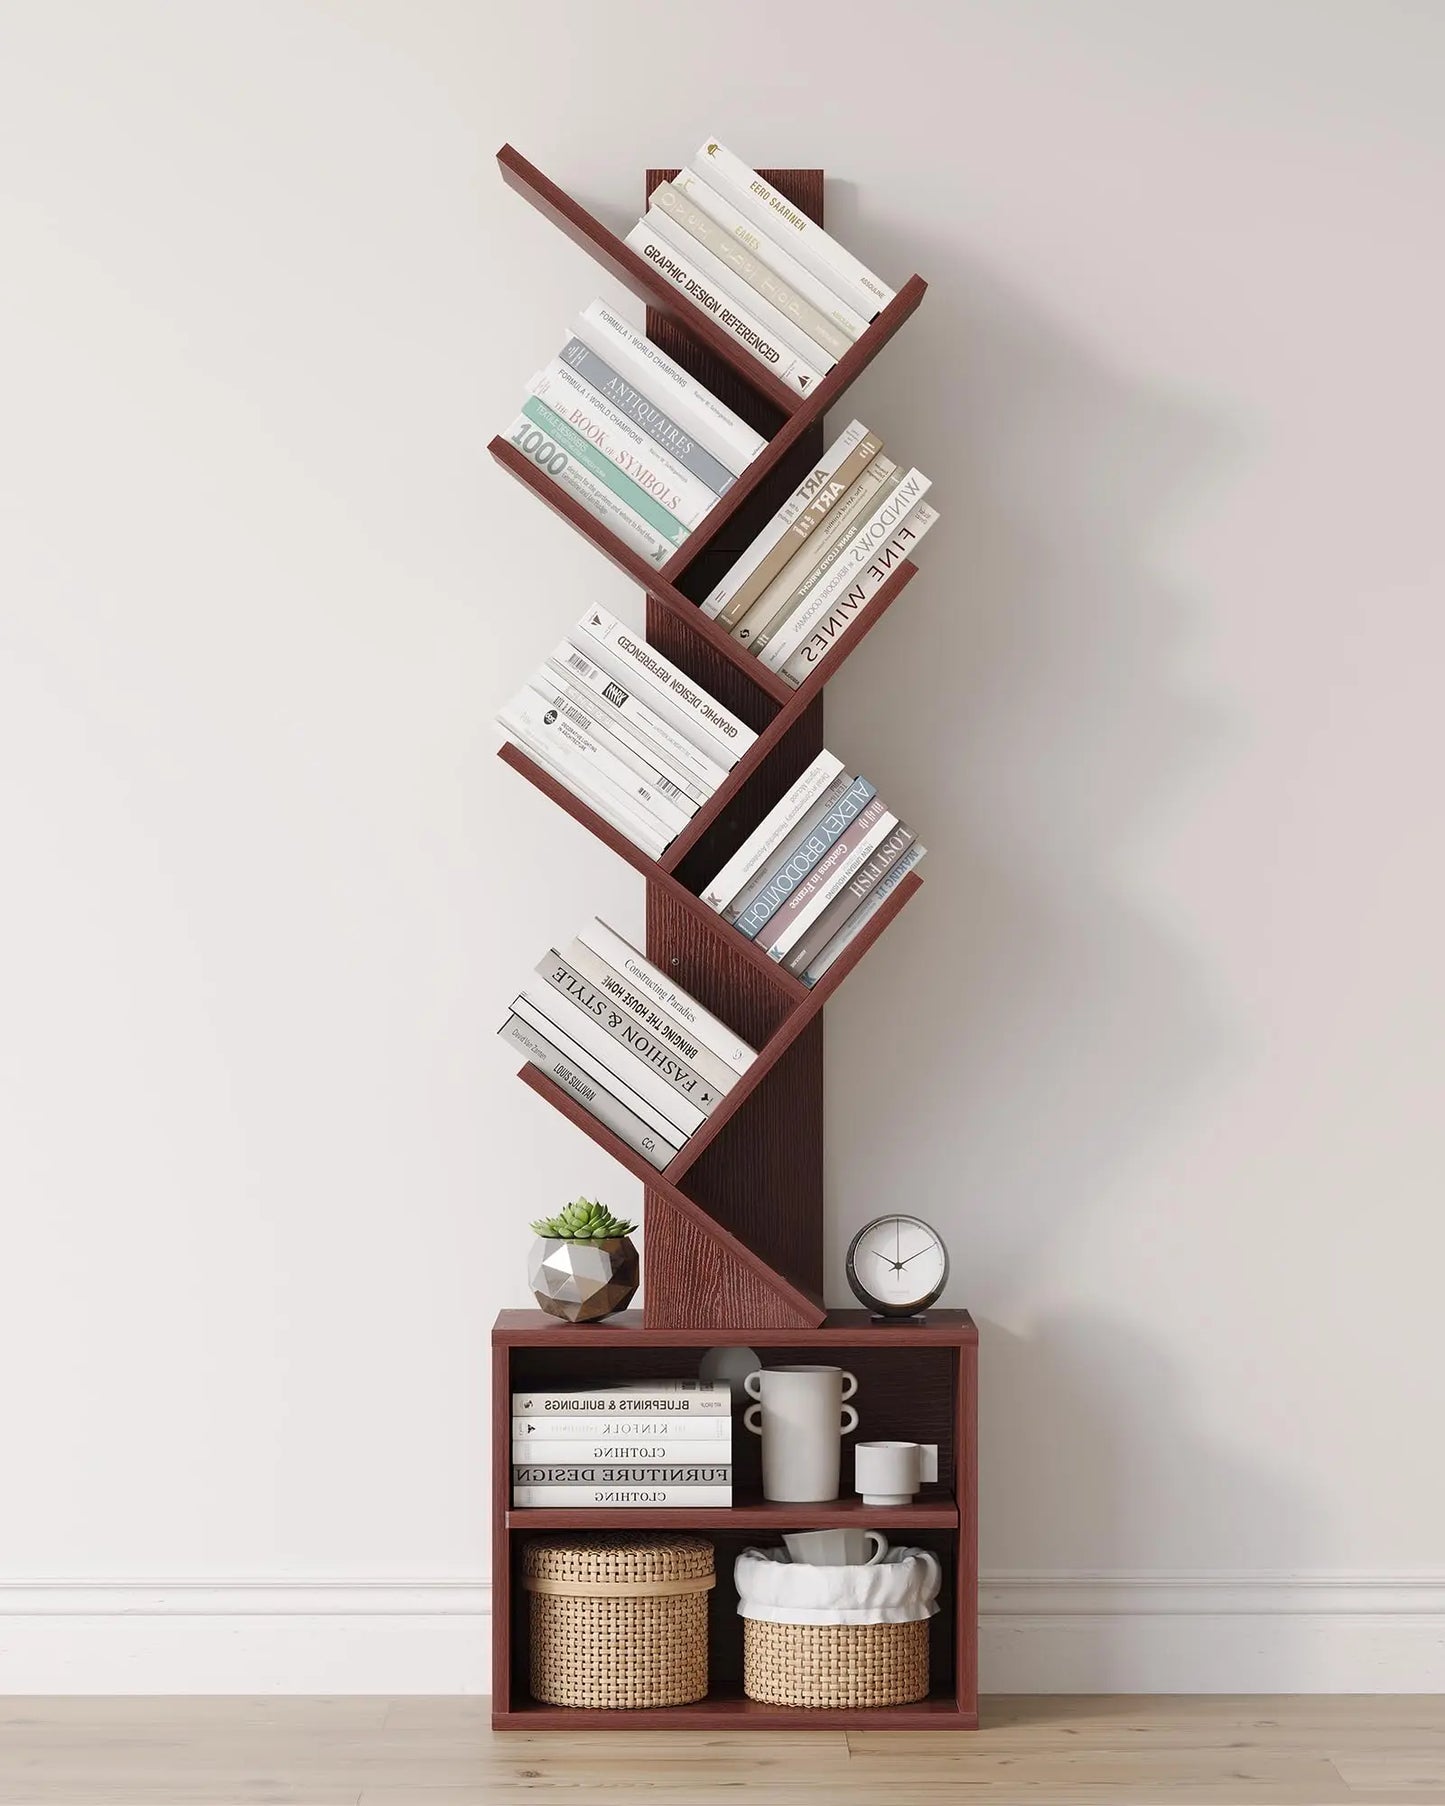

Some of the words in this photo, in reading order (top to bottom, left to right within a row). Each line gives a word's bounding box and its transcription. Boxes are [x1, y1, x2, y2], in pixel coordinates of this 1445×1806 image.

[749, 180, 772, 202] EERO
[767, 196, 808, 233] SAARINEN
[733, 225, 763, 252] EAMES
[642, 243, 689, 285] GRAPHIC
[683, 278, 723, 314] DESIGN
[717, 308, 782, 365] REFERENCED
[598, 309, 630, 338] FORMULA
[630, 337, 655, 360] WORLD
[651, 355, 689, 389] CHAMPIONS
[557, 368, 587, 396] FORMULA
[588, 395, 612, 417] WORLD
[608, 413, 645, 446] CHAMPIONS
[604, 375, 696, 457] ANTIQUAIRES
[510, 419, 572, 479] 1000
[567, 408, 611, 448] BOOK
[614, 448, 683, 512] SYMBOLS
[615, 634, 673, 685] REFERENCED
[668, 678, 703, 710] DESIGN
[698, 703, 740, 740] GRAPHIC
[817, 780, 873, 843] ALEXEY
[817, 842, 849, 878] Gardens
[844, 855, 864, 877] URBAN
[860, 843, 874, 859] NEW
[873, 825, 913, 869] LOST
[743, 835, 827, 930] BRODOVITCH
[810, 872, 823, 885] in
[824, 874, 848, 901] HOUSING
[847, 861, 883, 900] FISH
[883, 848, 920, 890] MAKING
[788, 881, 816, 911] France
[873, 886, 889, 901] IT
[550, 965, 609, 1018] STYLE
[599, 973, 627, 999] HOME
[621, 957, 671, 1002] Constructing
[603, 1009, 624, 1031] &
[621, 991, 650, 1019] HOUSE
[644, 1011, 665, 1032] THE
[511, 1028, 528, 1043] David
[659, 1024, 699, 1061] BRINGING
[620, 1024, 699, 1094] FASHION
[552, 1062, 574, 1083] LOUIS
[567, 1074, 598, 1103] SULLIVAN
